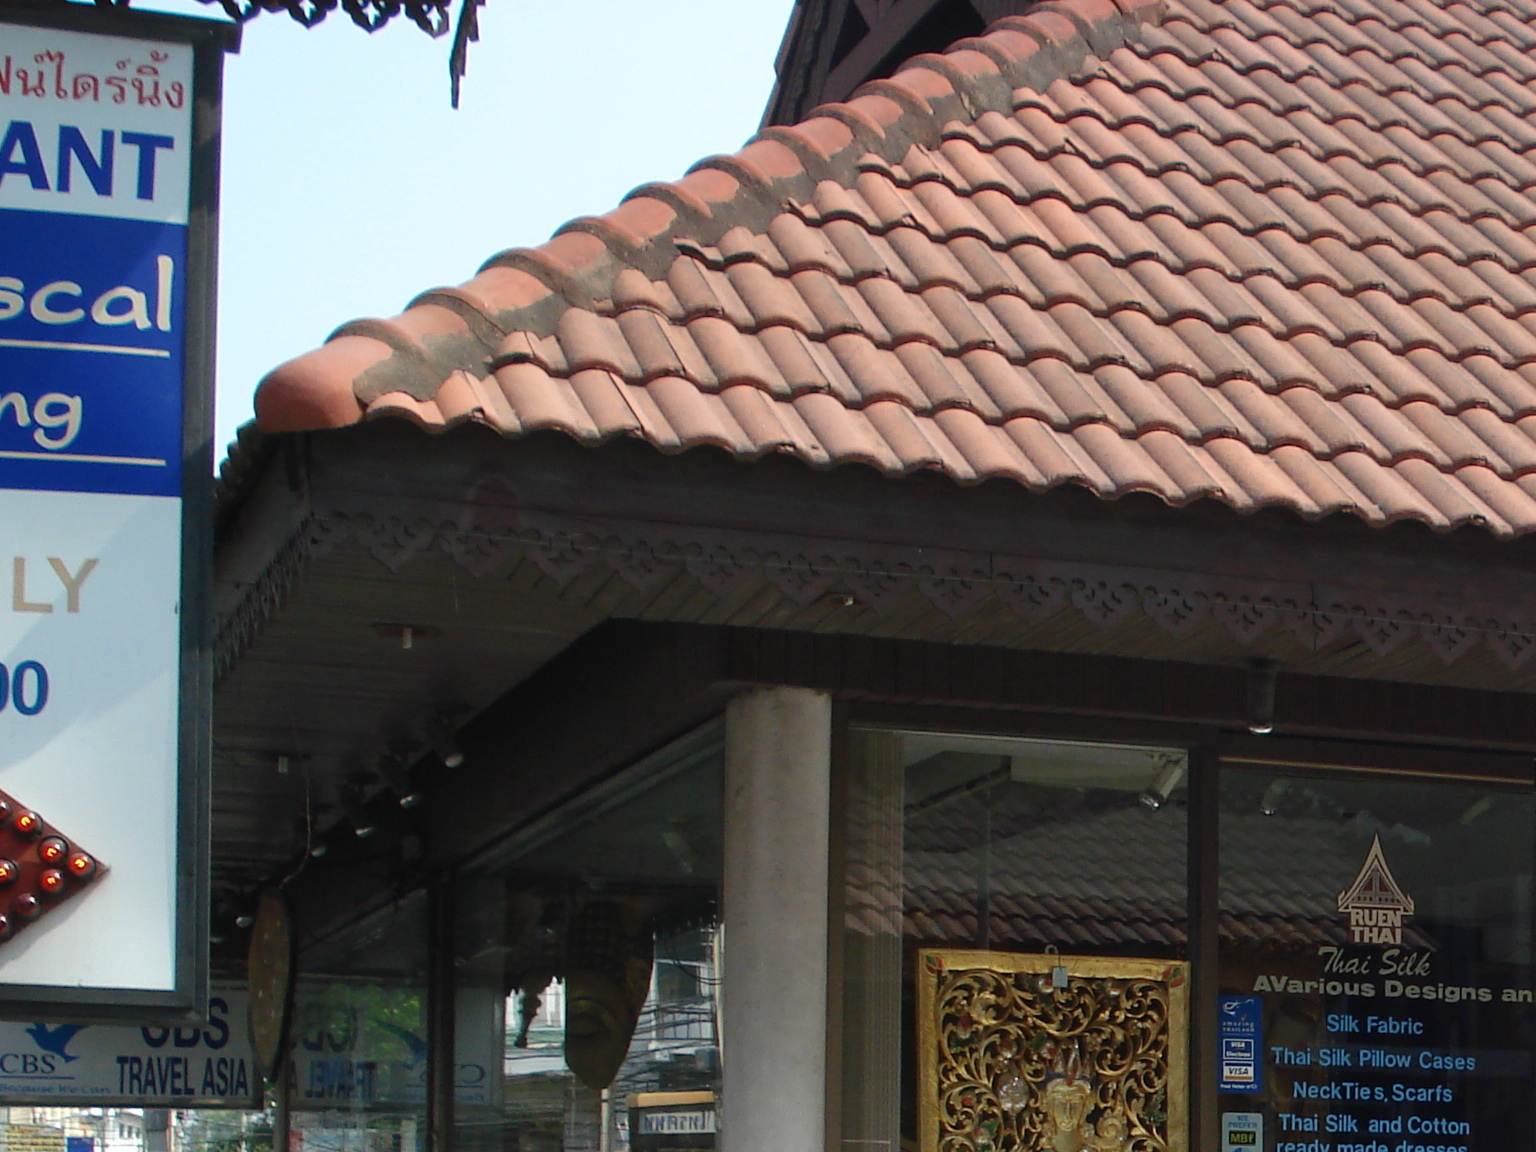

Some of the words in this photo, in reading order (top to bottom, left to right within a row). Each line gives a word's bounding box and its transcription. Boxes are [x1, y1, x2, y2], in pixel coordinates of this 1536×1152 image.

[12, 556, 100, 613] LY
[0, 660, 50, 716] 0
[1350, 908, 1400, 927] RUEN
[1351, 926, 1400, 944] THAI
[1317, 946, 1371, 974] Thai
[1379, 949, 1431, 977] Silk
[1384, 979, 1493, 1002] Designs
[1326, 1014, 1360, 1033] Silk
[1367, 1016, 1424, 1035] Fabric
[0, 1053, 56, 1075] CBS
[1271, 1046, 1311, 1066] Thai
[1319, 1048, 1352, 1067] Silk
[1359, 1050, 1411, 1069] Pillow
[1418, 1051, 1476, 1071] Cases
[117, 1056, 194, 1096] TRAVEL
[202, 1057, 248, 1096] ASIA
[1228, 1067, 1249, 1075] VISA
[1278, 1113, 1318, 1132] Thai
[1325, 1114, 1358, 1133] Silk
[1368, 1116, 1401, 1134] and
[1407, 1116, 1470, 1135] Cotton
